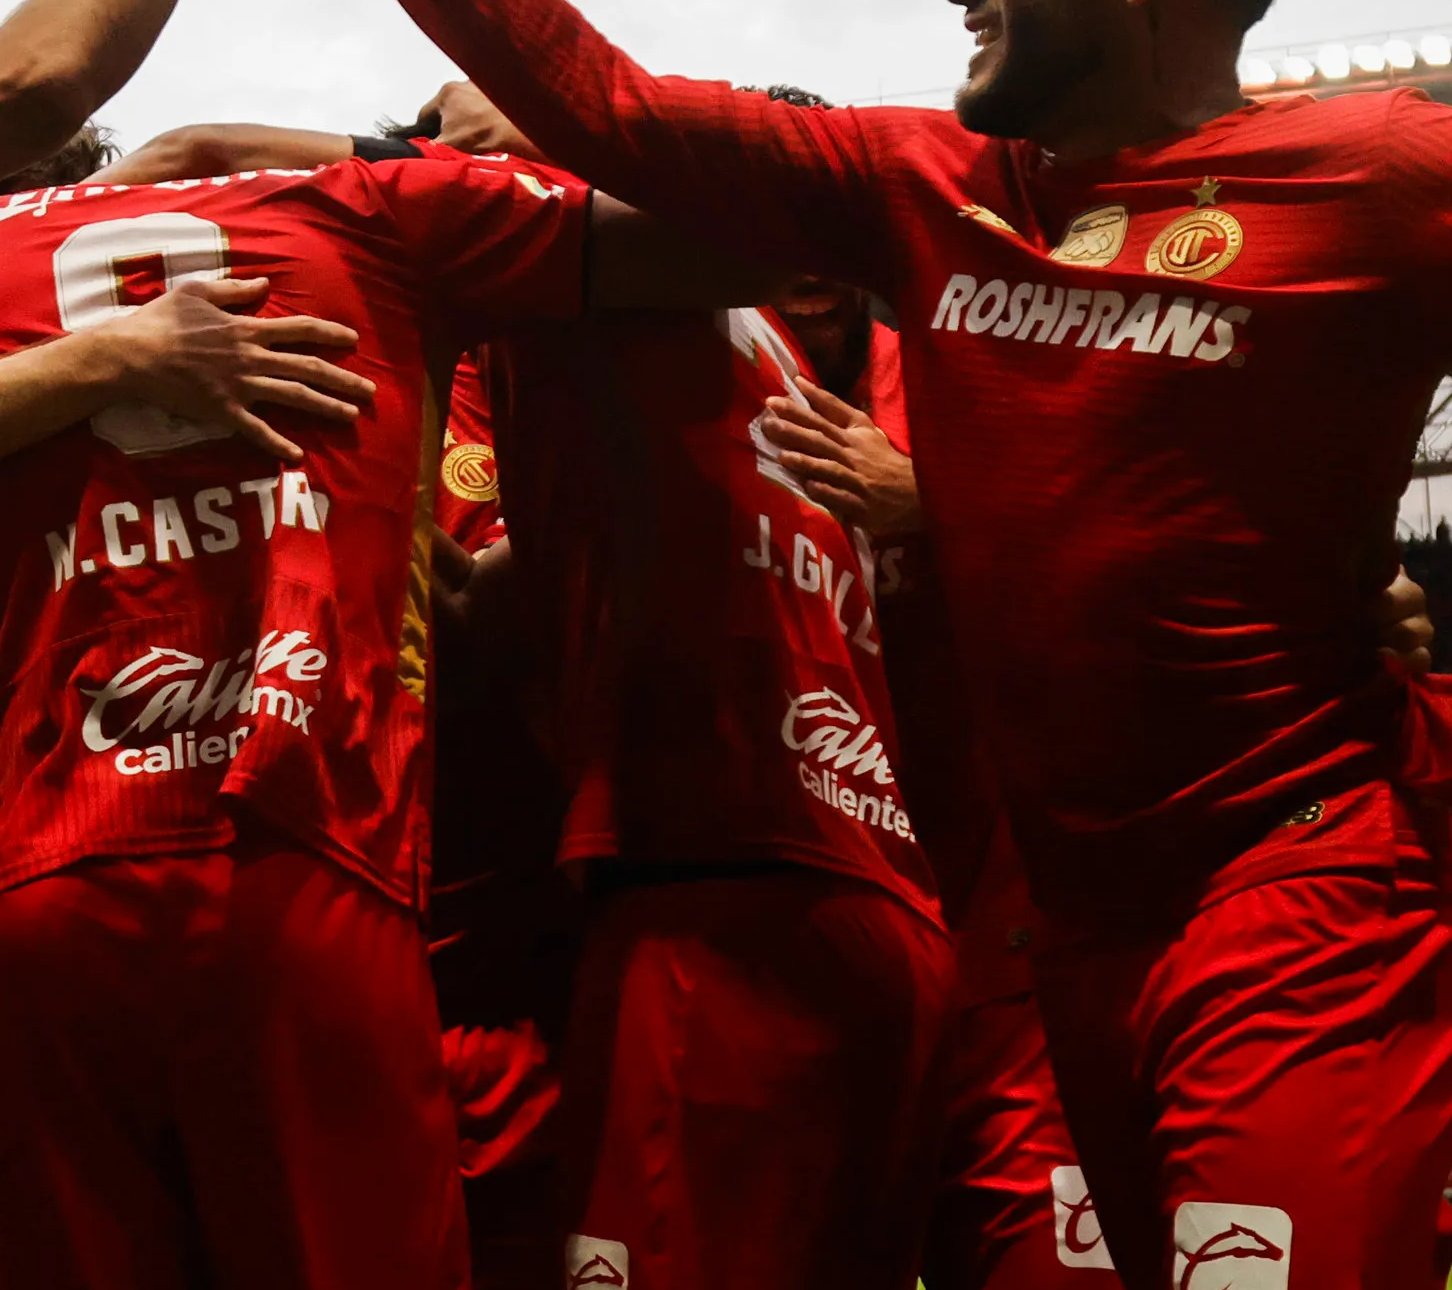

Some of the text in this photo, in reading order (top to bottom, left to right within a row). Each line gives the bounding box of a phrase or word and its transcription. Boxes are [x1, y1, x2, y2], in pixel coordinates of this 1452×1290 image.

[931, 273, 1252, 362] ROSHFRANS
[47, 470, 331, 591] N.CASTR
[798, 759, 916, 842] caliente.
